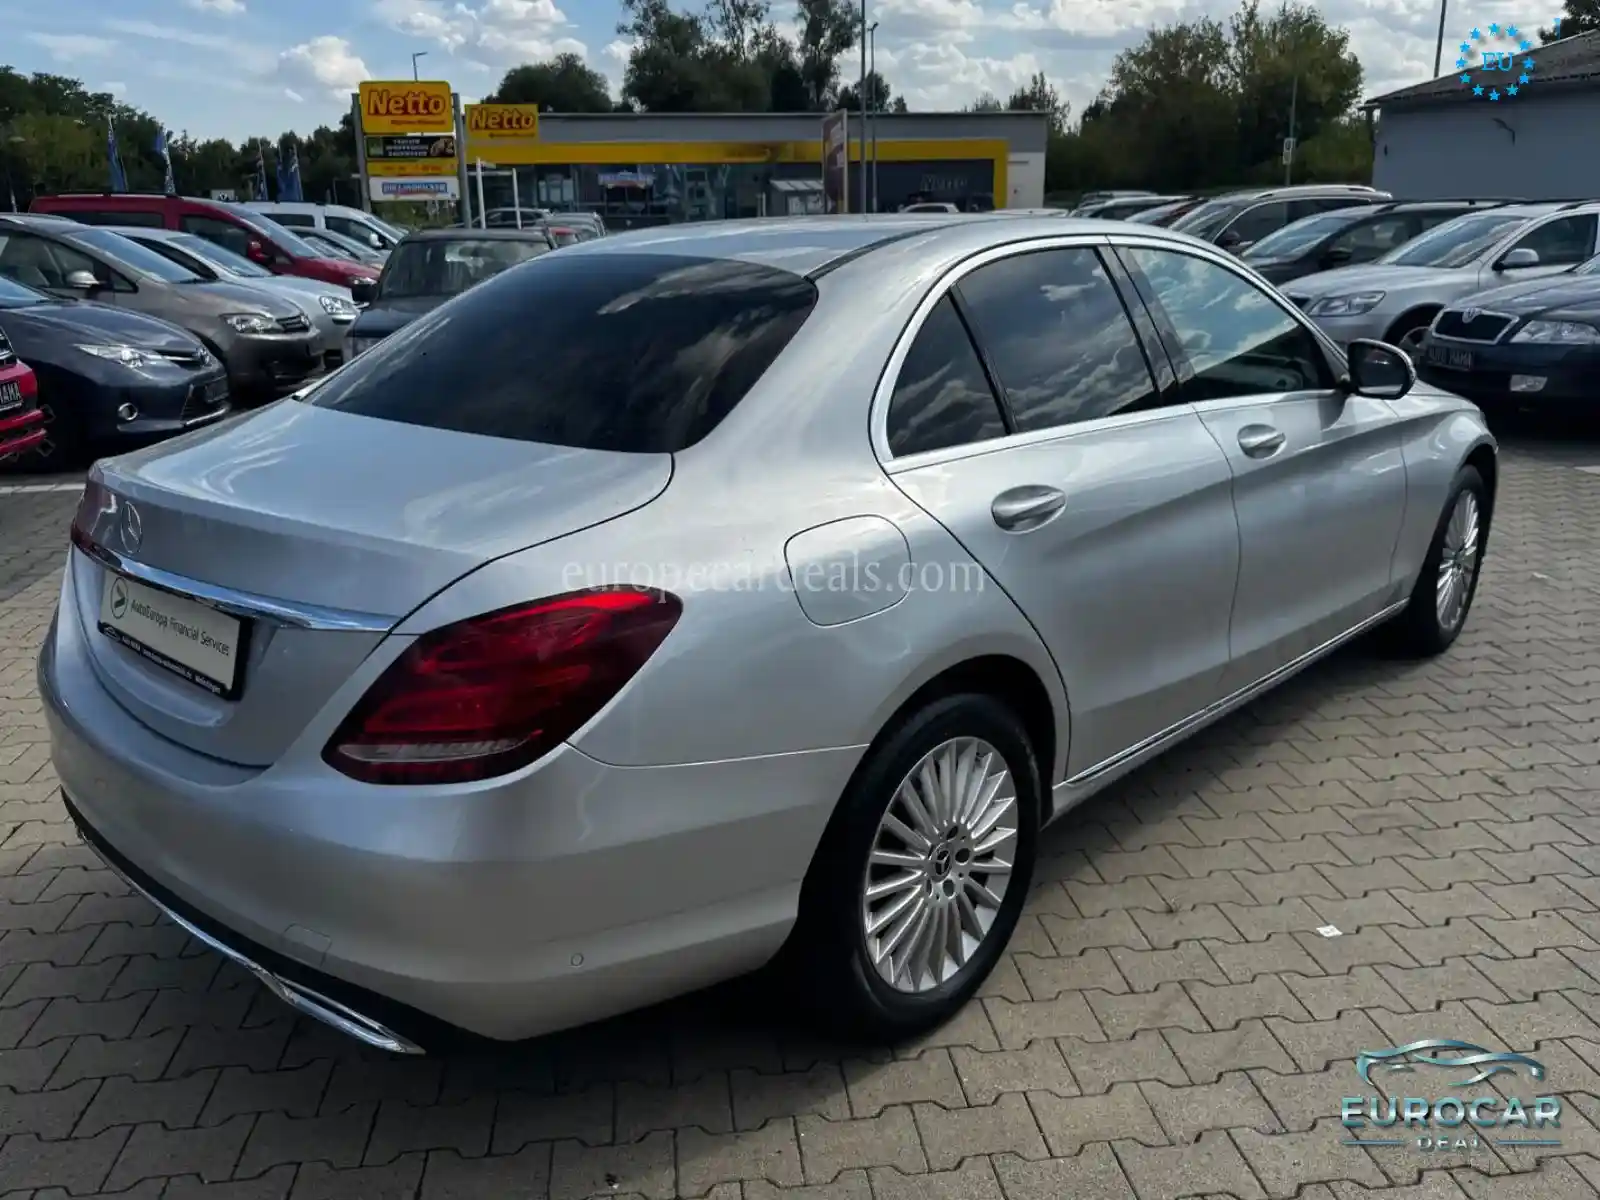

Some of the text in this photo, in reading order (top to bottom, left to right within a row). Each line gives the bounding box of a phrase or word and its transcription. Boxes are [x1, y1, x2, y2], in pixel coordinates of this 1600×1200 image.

[367, 89, 446, 116] Netto
[470, 107, 536, 131] Netto
[131, 600, 230, 656] AutoEuropa Financial Services
